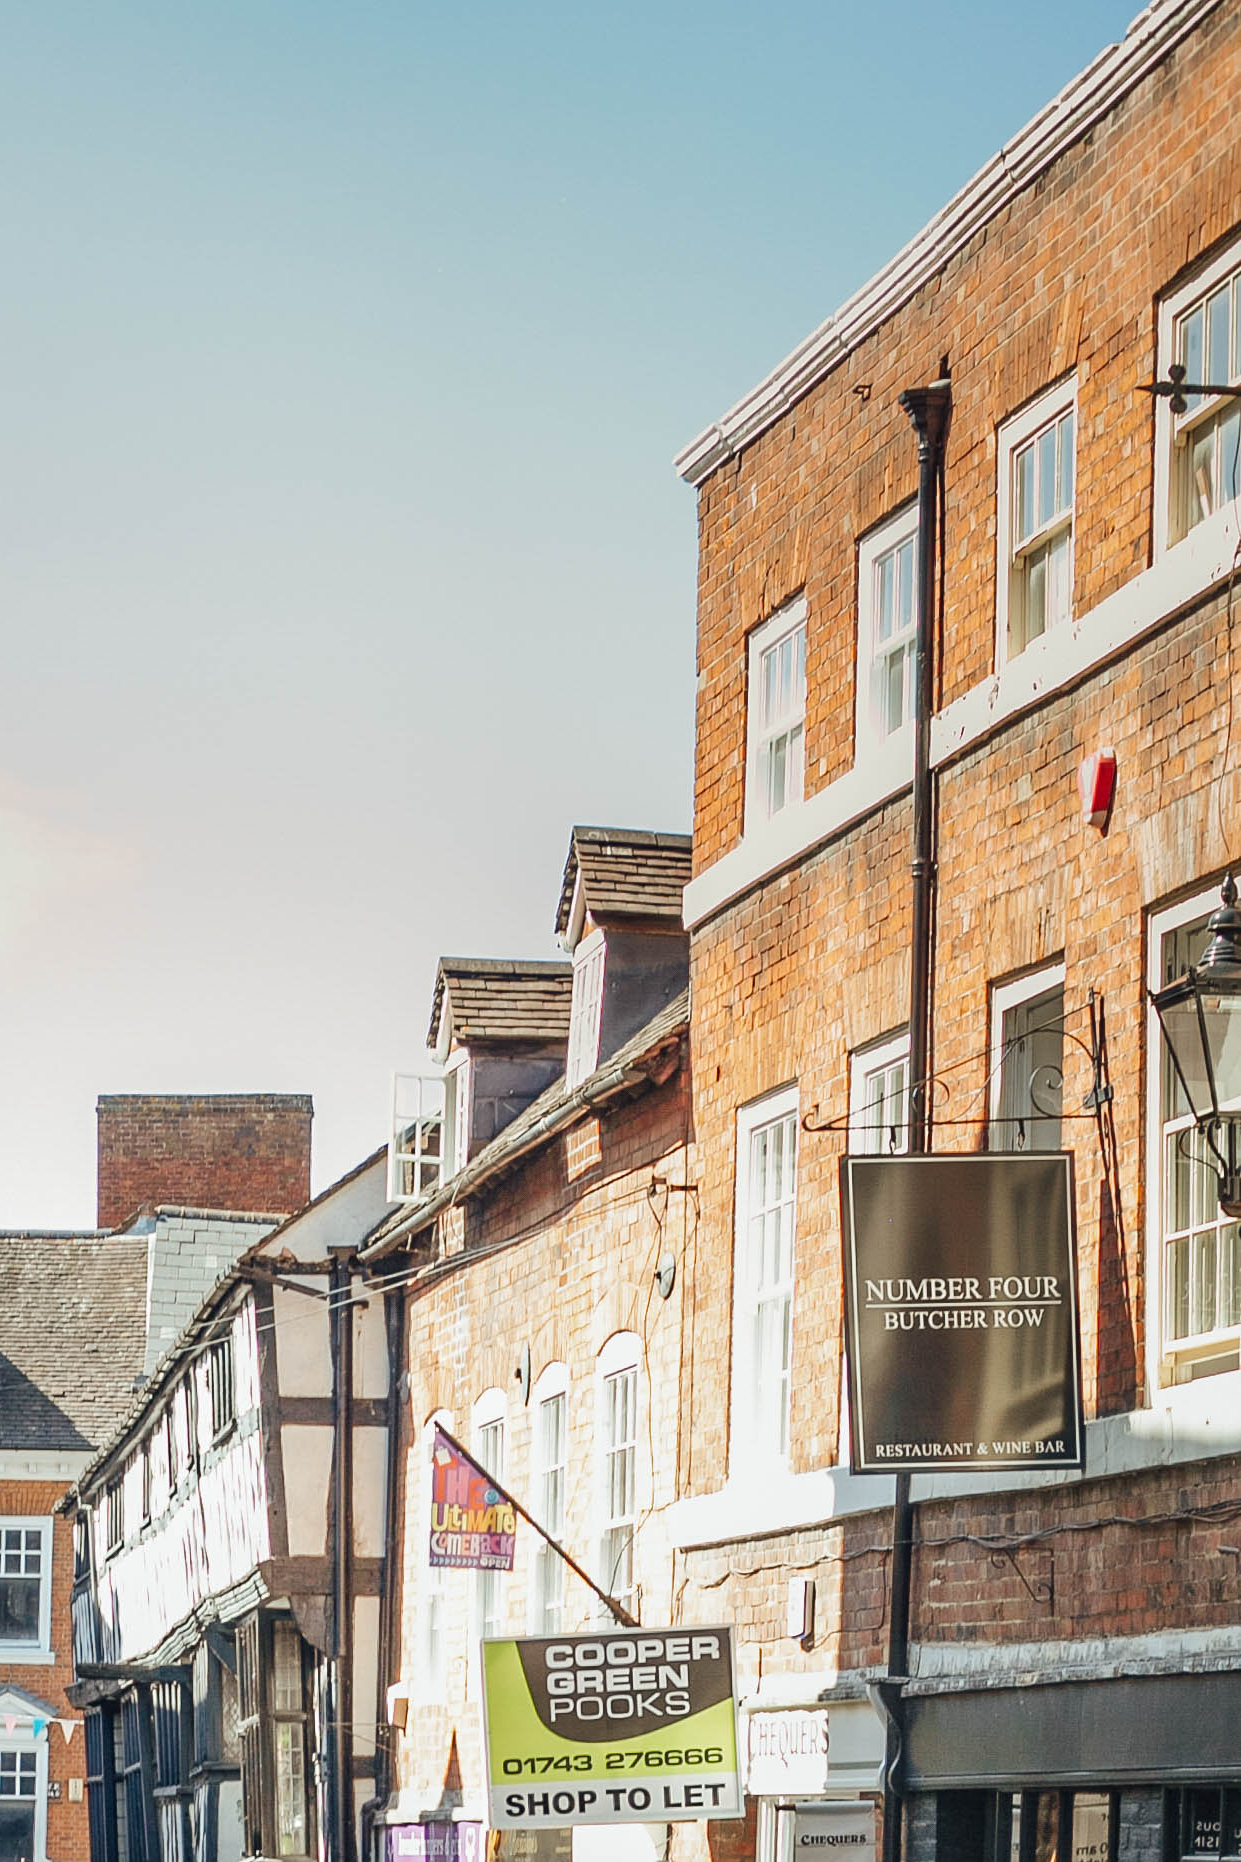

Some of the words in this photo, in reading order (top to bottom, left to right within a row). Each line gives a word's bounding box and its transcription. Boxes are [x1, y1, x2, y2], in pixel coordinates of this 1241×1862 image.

[865, 1278, 982, 1302] NUMBER
[988, 1276, 1061, 1299] FOUR
[884, 1309, 988, 1331] BUTCHER
[993, 1308, 1045, 1329] ROW
[875, 1442, 973, 1458] RESTAURANT
[977, 1442, 988, 1456] &
[992, 1441, 1031, 1455] WINE
[1034, 1440, 1066, 1454] BAR
[433, 1456, 487, 1511] THE
[545, 1635, 720, 1669] COOPER
[546, 1663, 689, 1696] GREEN
[549, 1690, 691, 1723] POOKS
[748, 1717, 830, 1767] CHEQUERS
[502, 1754, 594, 1776] 01743
[605, 1747, 724, 1769] 276666
[505, 1789, 598, 1818] SHOP
[606, 1786, 652, 1813] TO
[663, 1783, 726, 1809] LET
[801, 1832, 867, 1847] CHEQUERS
